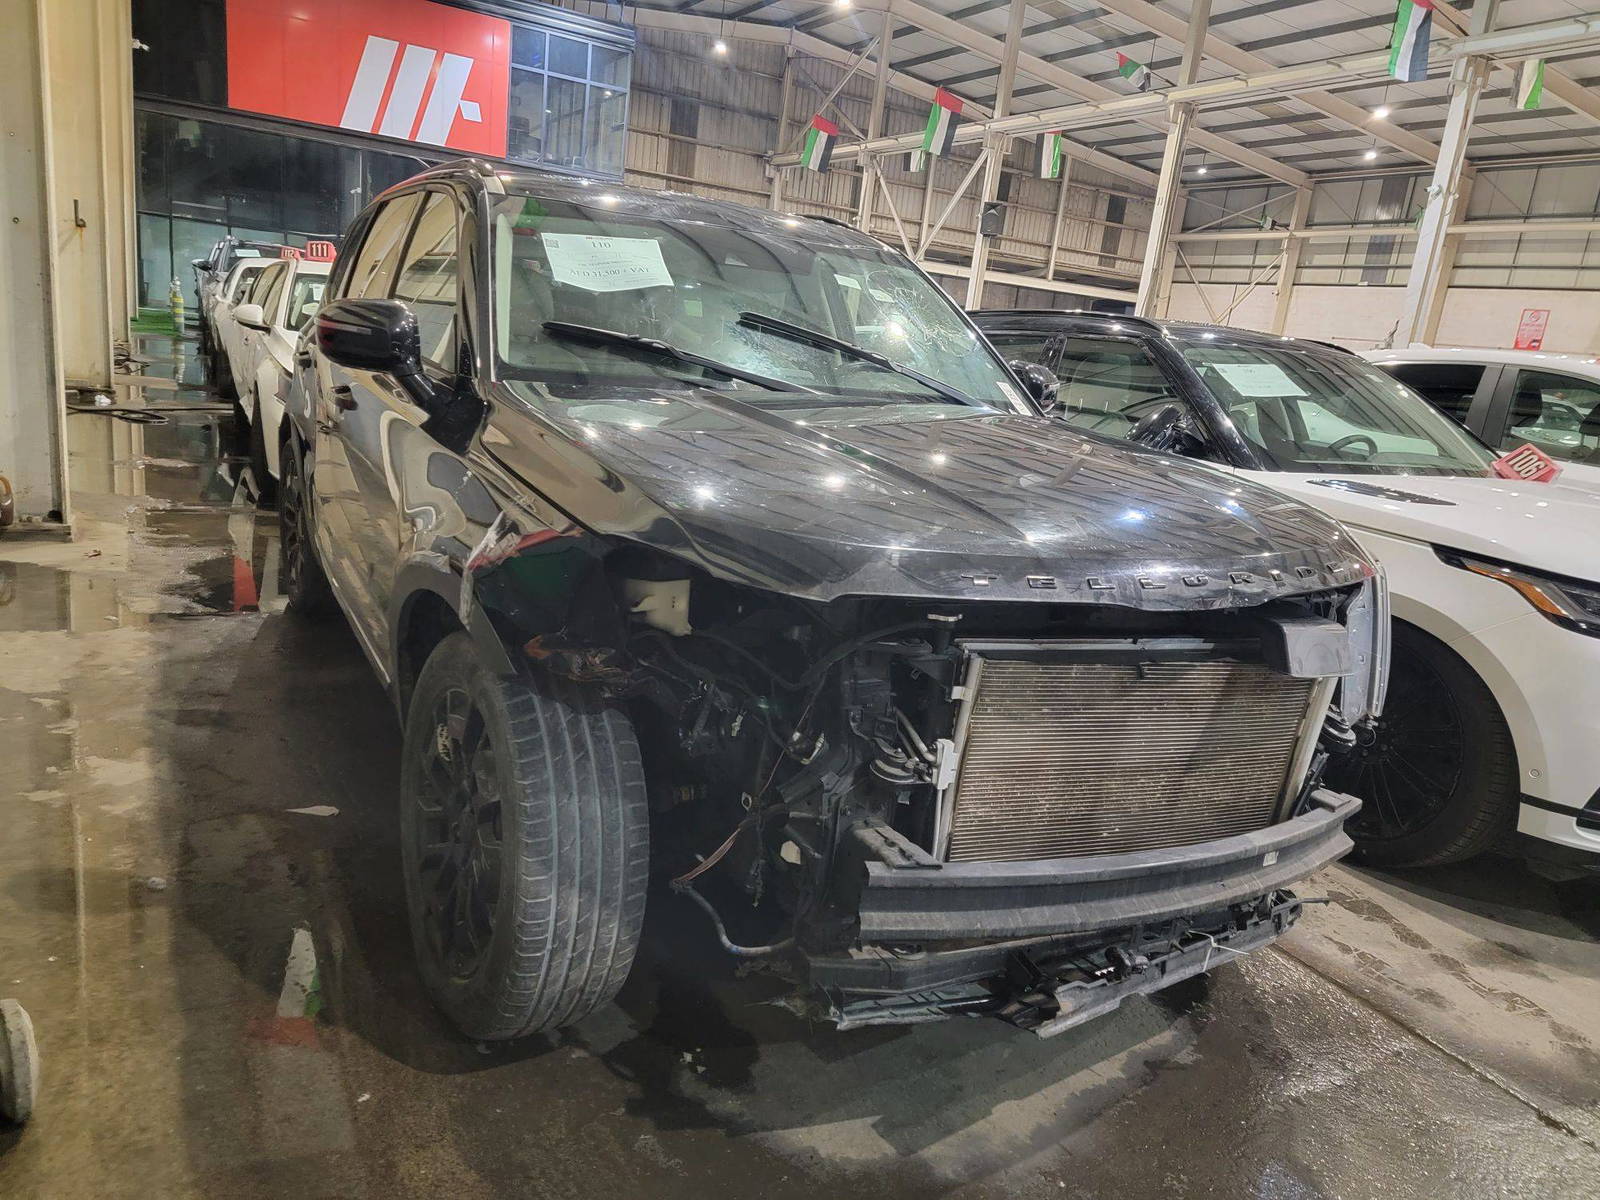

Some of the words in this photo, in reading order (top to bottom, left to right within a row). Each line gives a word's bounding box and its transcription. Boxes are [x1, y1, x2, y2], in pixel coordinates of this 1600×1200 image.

[311, 244, 327, 257] 111
[1508, 450, 1546, 478] 106
[961, 561, 1345, 590] TELLURIDE
